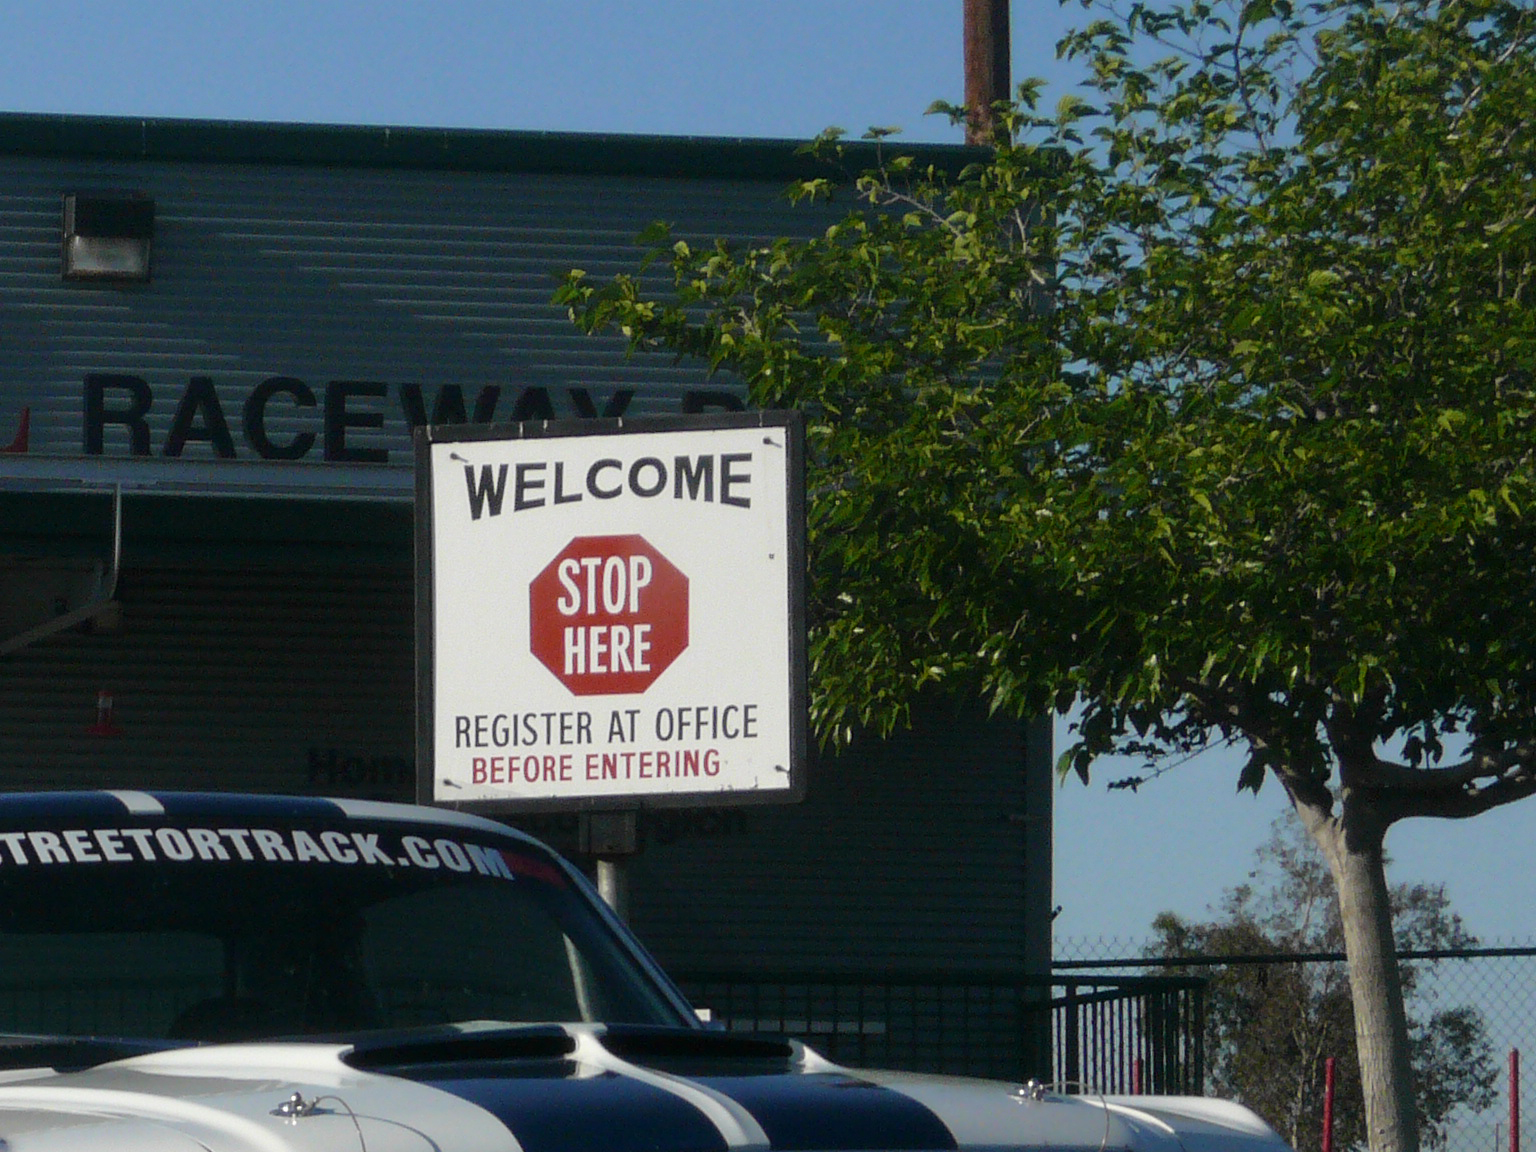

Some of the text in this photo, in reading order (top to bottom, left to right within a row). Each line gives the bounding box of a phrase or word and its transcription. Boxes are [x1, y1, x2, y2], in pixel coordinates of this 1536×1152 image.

[464, 452, 753, 520] WELCOME
[558, 555, 653, 616] STOP
[564, 624, 651, 675] HERE
[455, 704, 758, 748] REGISTER AT OFFICE
[307, 747, 414, 788] Hom
[472, 749, 720, 784] BEFORE ENTERING
